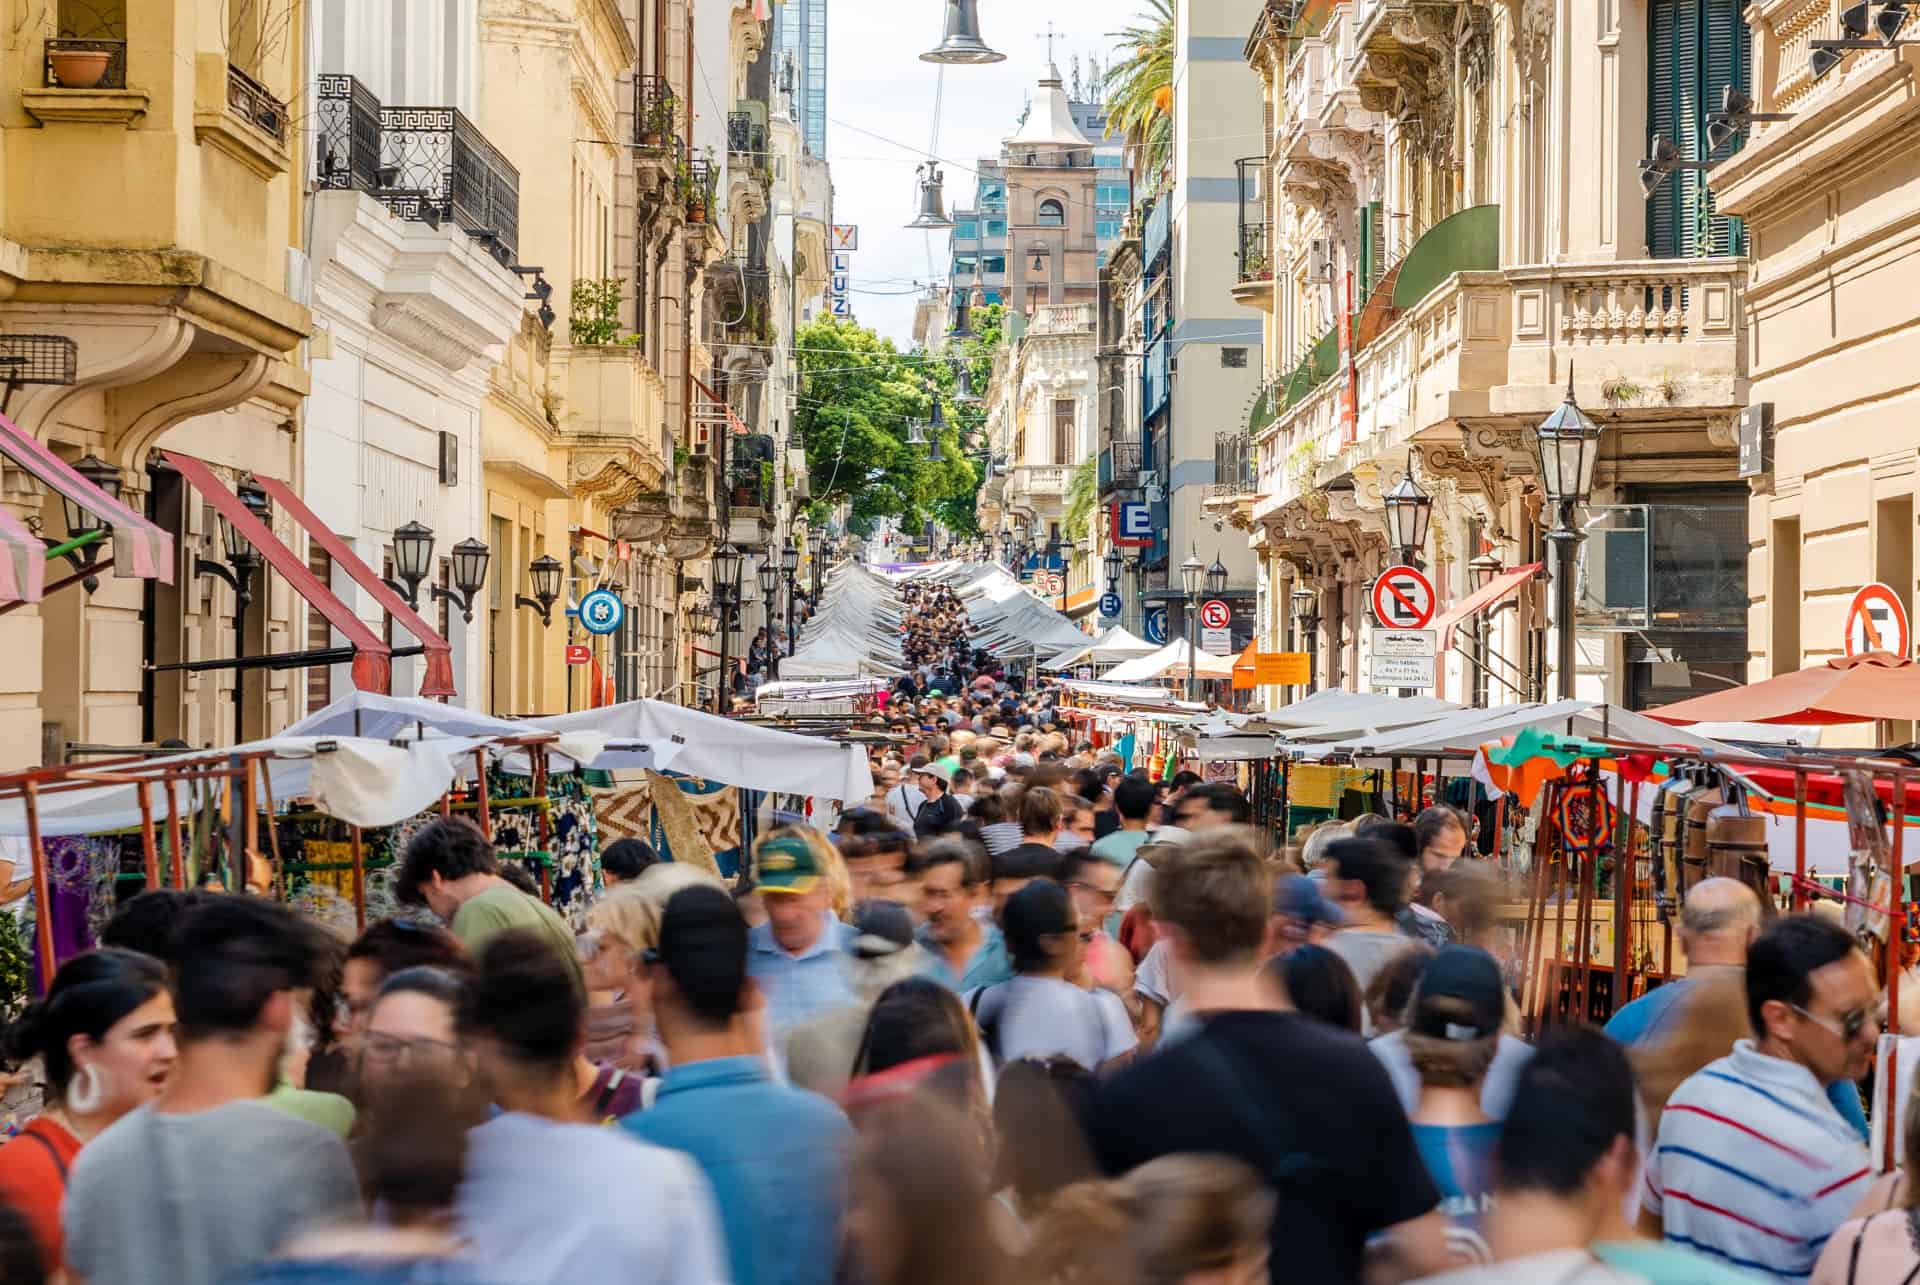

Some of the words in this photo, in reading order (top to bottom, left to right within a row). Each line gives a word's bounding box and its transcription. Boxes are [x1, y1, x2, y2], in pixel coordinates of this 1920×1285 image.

[835, 256, 845, 313] LUZ
[1127, 505, 1152, 533] E
[1393, 583, 1416, 618] E
